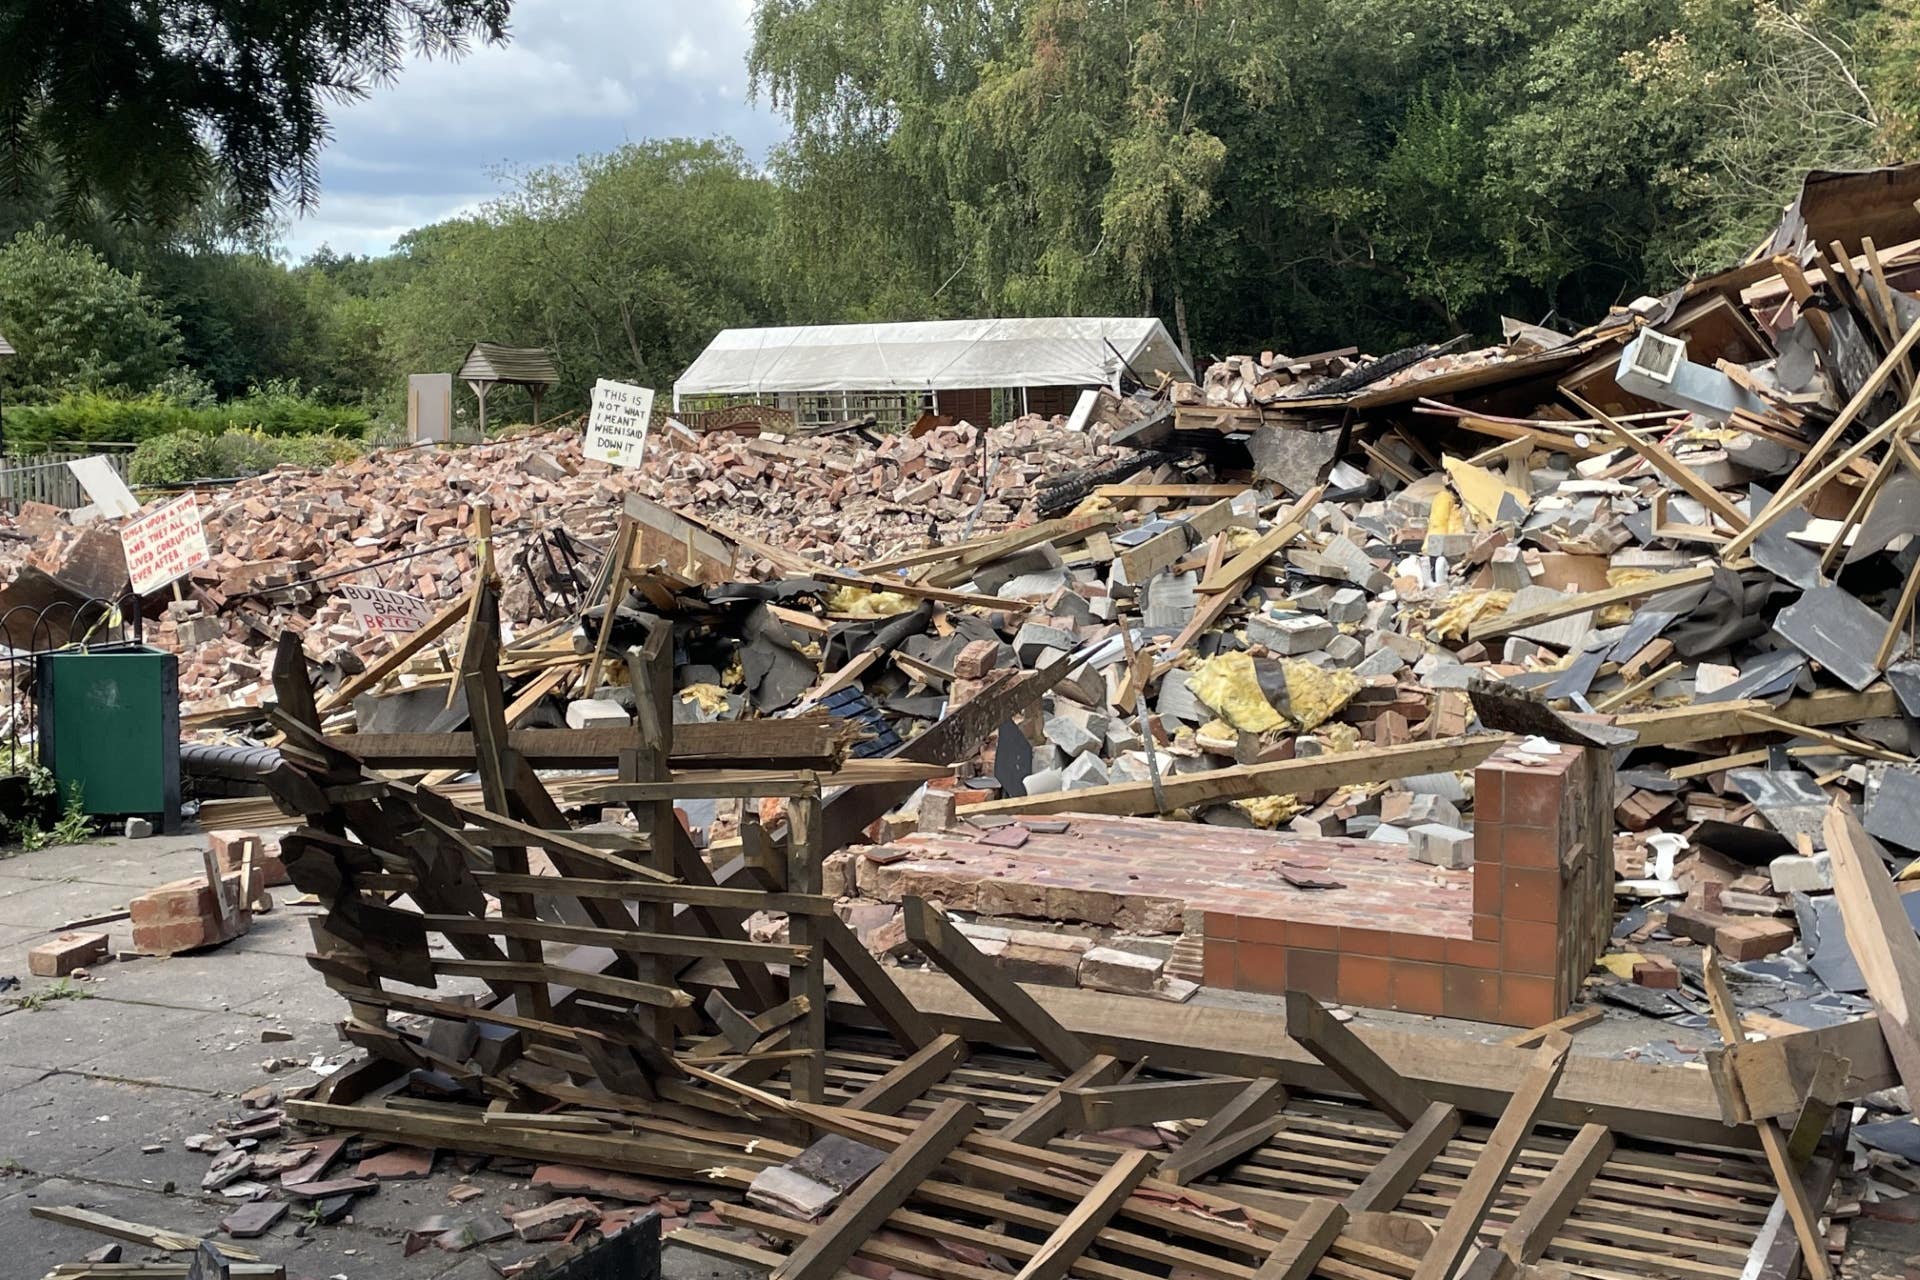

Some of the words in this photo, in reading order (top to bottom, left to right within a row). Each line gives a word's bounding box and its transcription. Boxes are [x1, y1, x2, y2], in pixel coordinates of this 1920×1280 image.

[604, 389, 627, 402] THIS
[632, 395, 641, 406] IS
[598, 401, 620, 411] NOT
[624, 406, 645, 418] WHAT
[604, 415, 637, 427] MEANT
[595, 423, 621, 435] WHEN
[625, 428, 643, 439] SAID
[597, 437, 623, 450] DOWN
[625, 442, 635, 453] IT
[123, 524, 143, 541] ONCE
[145, 513, 166, 528] UPON
[177, 497, 195, 512] TIME
[129, 540, 145, 555] AND
[148, 527, 168, 543] THEY
[169, 519, 185, 530] ALL
[129, 551, 154, 570] LIVED
[156, 520, 200, 555] CORRUPTLY
[168, 561, 184, 575] THE
[187, 552, 202, 566] END
[132, 566, 153, 584] EVER
[345, 586, 404, 605] BUILD
[407, 597, 428, 612] IT
[372, 602, 417, 618] BACK
